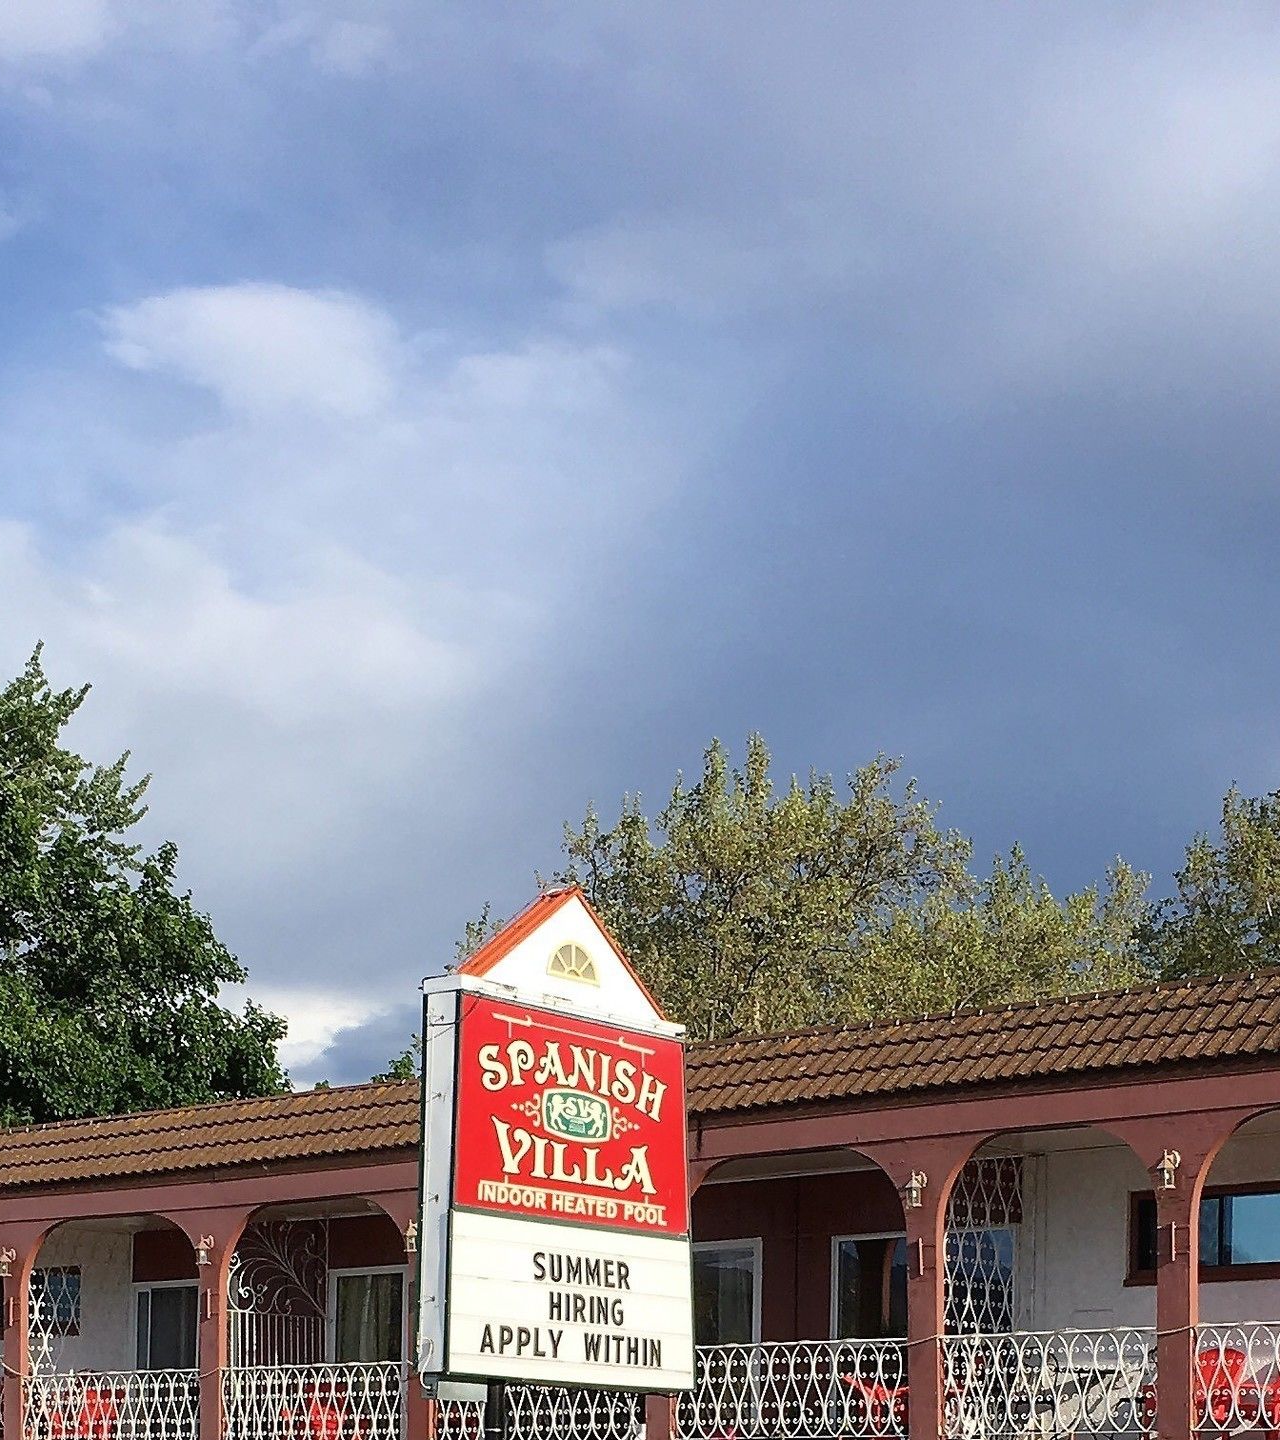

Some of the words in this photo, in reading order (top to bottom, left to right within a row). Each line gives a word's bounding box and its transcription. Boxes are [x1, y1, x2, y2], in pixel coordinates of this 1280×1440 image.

[478, 1039, 668, 1123] SPANISH
[491, 1115, 658, 1195] VILLA
[477, 1182, 548, 1210] INDOOR
[551, 1192, 618, 1219] HEATED
[624, 1206, 668, 1227] POOL
[532, 1252, 631, 1290] SUMMER
[548, 1291, 625, 1326] HIRING
[479, 1323, 564, 1359] APPLY
[584, 1332, 662, 1368] WITHIN
